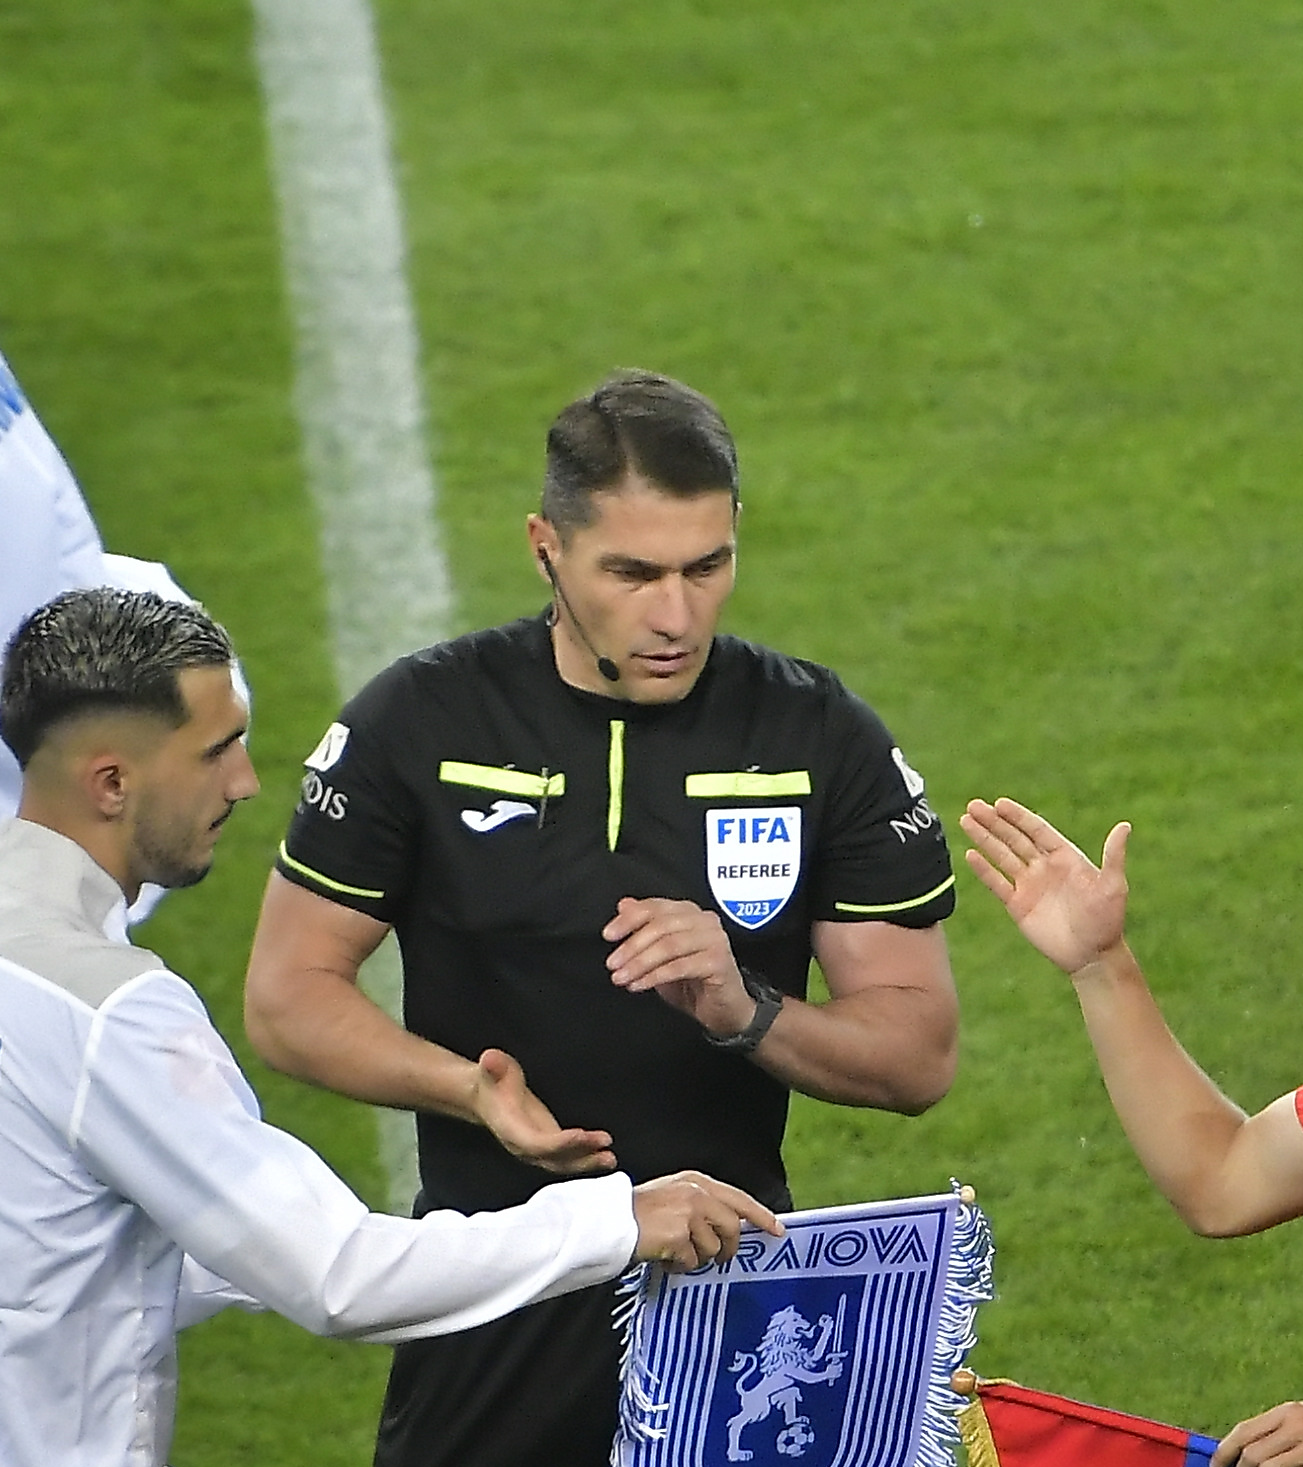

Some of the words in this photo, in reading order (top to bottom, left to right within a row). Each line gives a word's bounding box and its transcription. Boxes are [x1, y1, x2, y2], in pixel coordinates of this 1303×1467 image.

[717, 817, 790, 844] FIFA
[717, 863, 791, 878] REFEREE
[736, 902, 770, 916] 2023
[684, 1223, 929, 1276] RAIOVA
